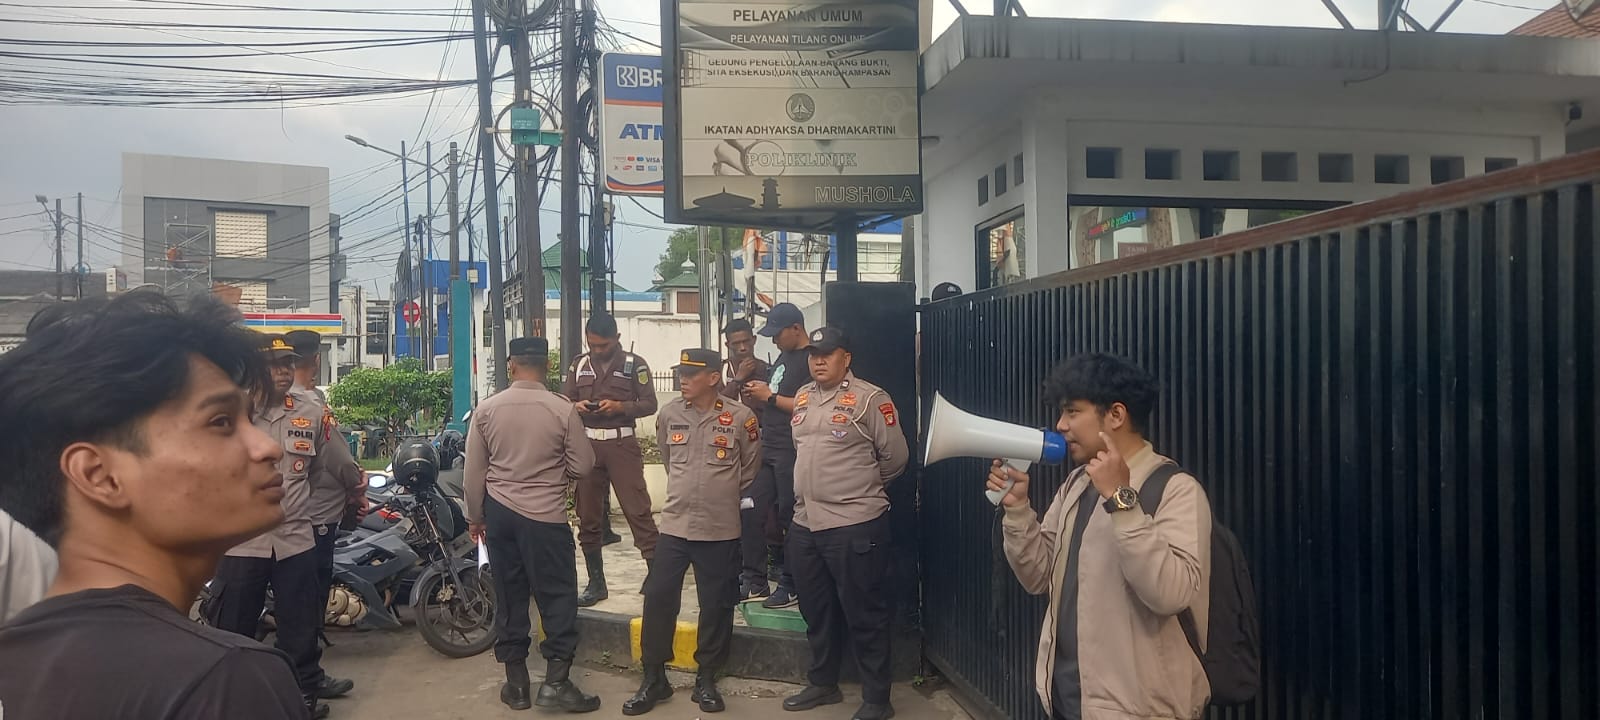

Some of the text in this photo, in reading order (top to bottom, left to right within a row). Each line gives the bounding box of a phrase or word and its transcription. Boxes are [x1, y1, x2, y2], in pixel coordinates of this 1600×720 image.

[733, 10, 863, 22] PELAYANAN UMUM
[730, 34, 866, 44] PELAYANAN TILANG ONLINE
[708, 58, 746, 66] GEDUNG
[749, 58, 817, 67] PENGELOLAAN
[860, 58, 890, 67] BUKTI,
[639, 68, 662, 87] BR
[704, 125, 896, 135] IKATAN ADHYAKSA DHARMAKARTINI
[747, 152, 857, 167] POLIKLINIK
[815, 186, 915, 203] MUSHOLA
[833, 405, 855, 414] POLRI
[712, 425, 734, 434] POLRI
[288, 430, 312, 440] POLRI
